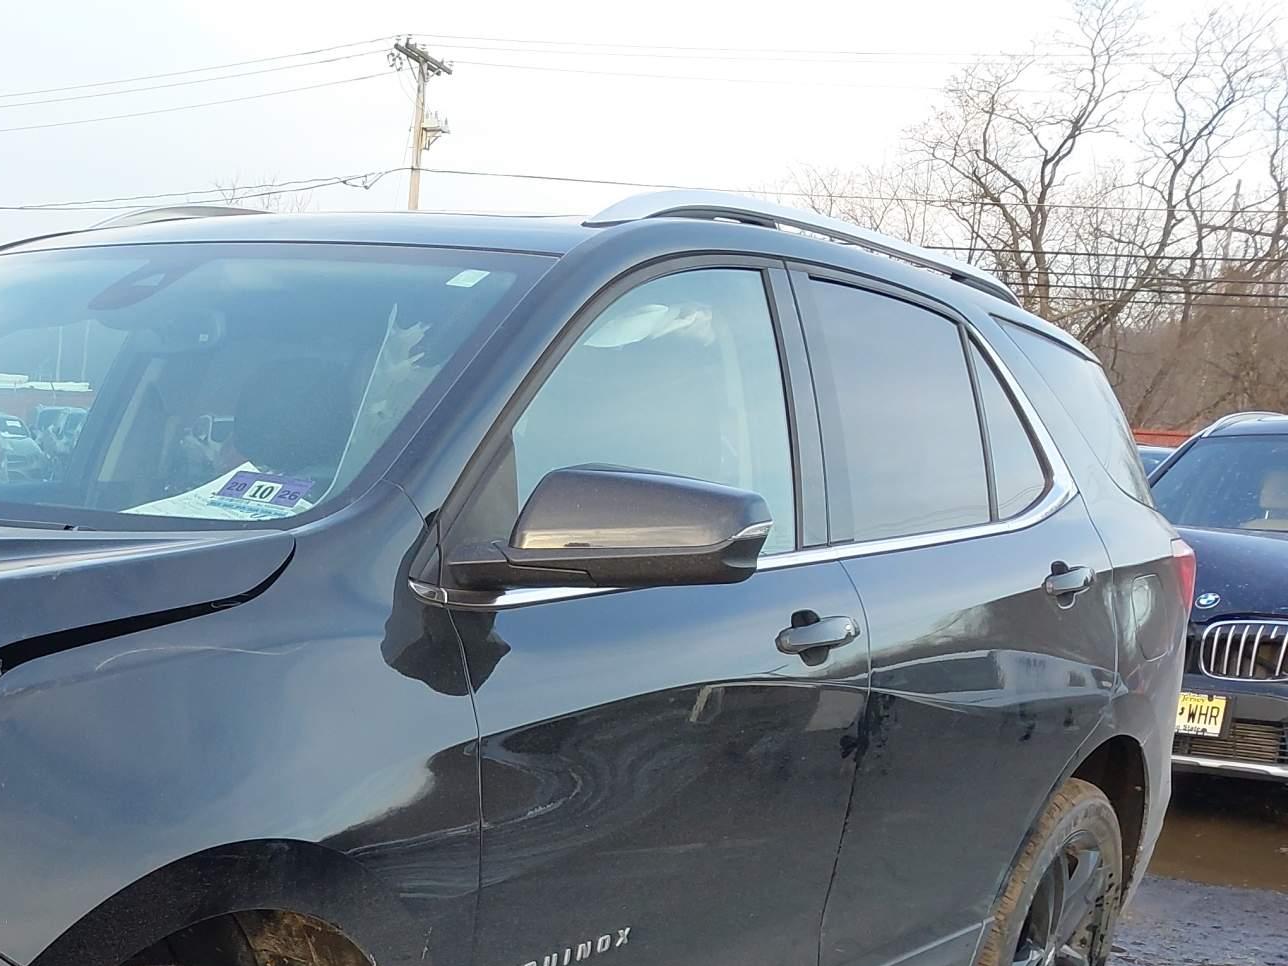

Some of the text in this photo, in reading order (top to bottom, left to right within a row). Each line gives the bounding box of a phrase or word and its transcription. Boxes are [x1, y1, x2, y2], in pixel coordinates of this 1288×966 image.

[226, 482, 300, 500] 20 10 26
